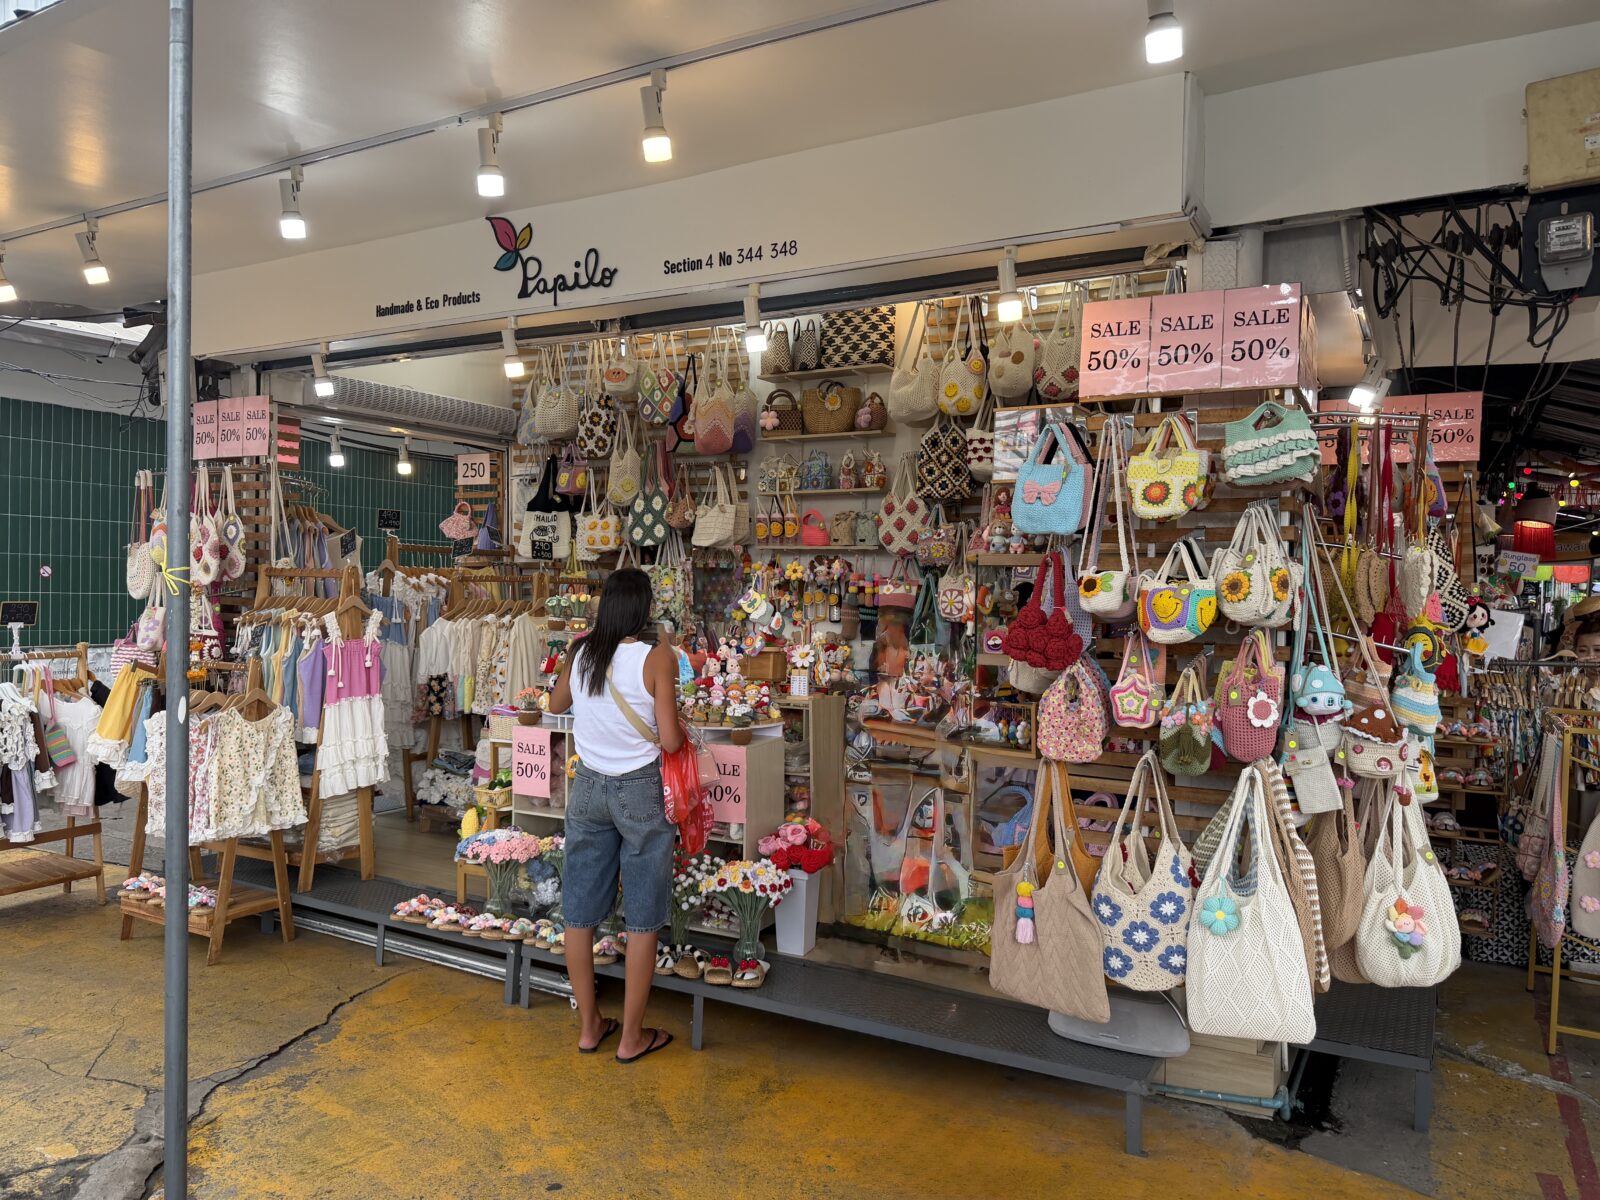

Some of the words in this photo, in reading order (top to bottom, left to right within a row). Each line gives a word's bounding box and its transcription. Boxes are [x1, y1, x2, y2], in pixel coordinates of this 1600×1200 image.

[664, 257, 702, 275] Section
[705, 254, 714, 268] 4
[719, 251, 732, 266] No
[736, 245, 763, 264] 344
[770, 240, 797, 258] 348
[518, 248, 618, 306] Papilo
[376, 301, 414, 317] Handmade
[416, 299, 423, 311] &
[425, 297, 439, 310] Eco
[443, 291, 481, 307] Products
[1160, 314, 1214, 333] SALE
[1233, 308, 1290, 327] SALE
[1090, 320, 1141, 338] SALE
[1158, 342, 1214, 366] 50%
[1231, 337, 1290, 362] 50%
[1087, 348, 1141, 371] 50%
[196, 414, 215, 425] SALE
[221, 411, 240, 422] SALE
[246, 410, 266, 420] SALE
[1433, 408, 1475, 419] SALE
[195, 432, 215, 445] 50%
[220, 429, 241, 442] 50%
[245, 427, 267, 440] 50%
[1431, 428, 1474, 444] 50%
[462, 462, 485, 478] 250
[534, 541, 550, 551] 290
[1509, 561, 1526, 573] 50
[517, 742, 546, 756] SALE
[516, 762, 546, 780] 50%
[716, 763, 740, 776] ALE
[709, 785, 741, 803] 0%
